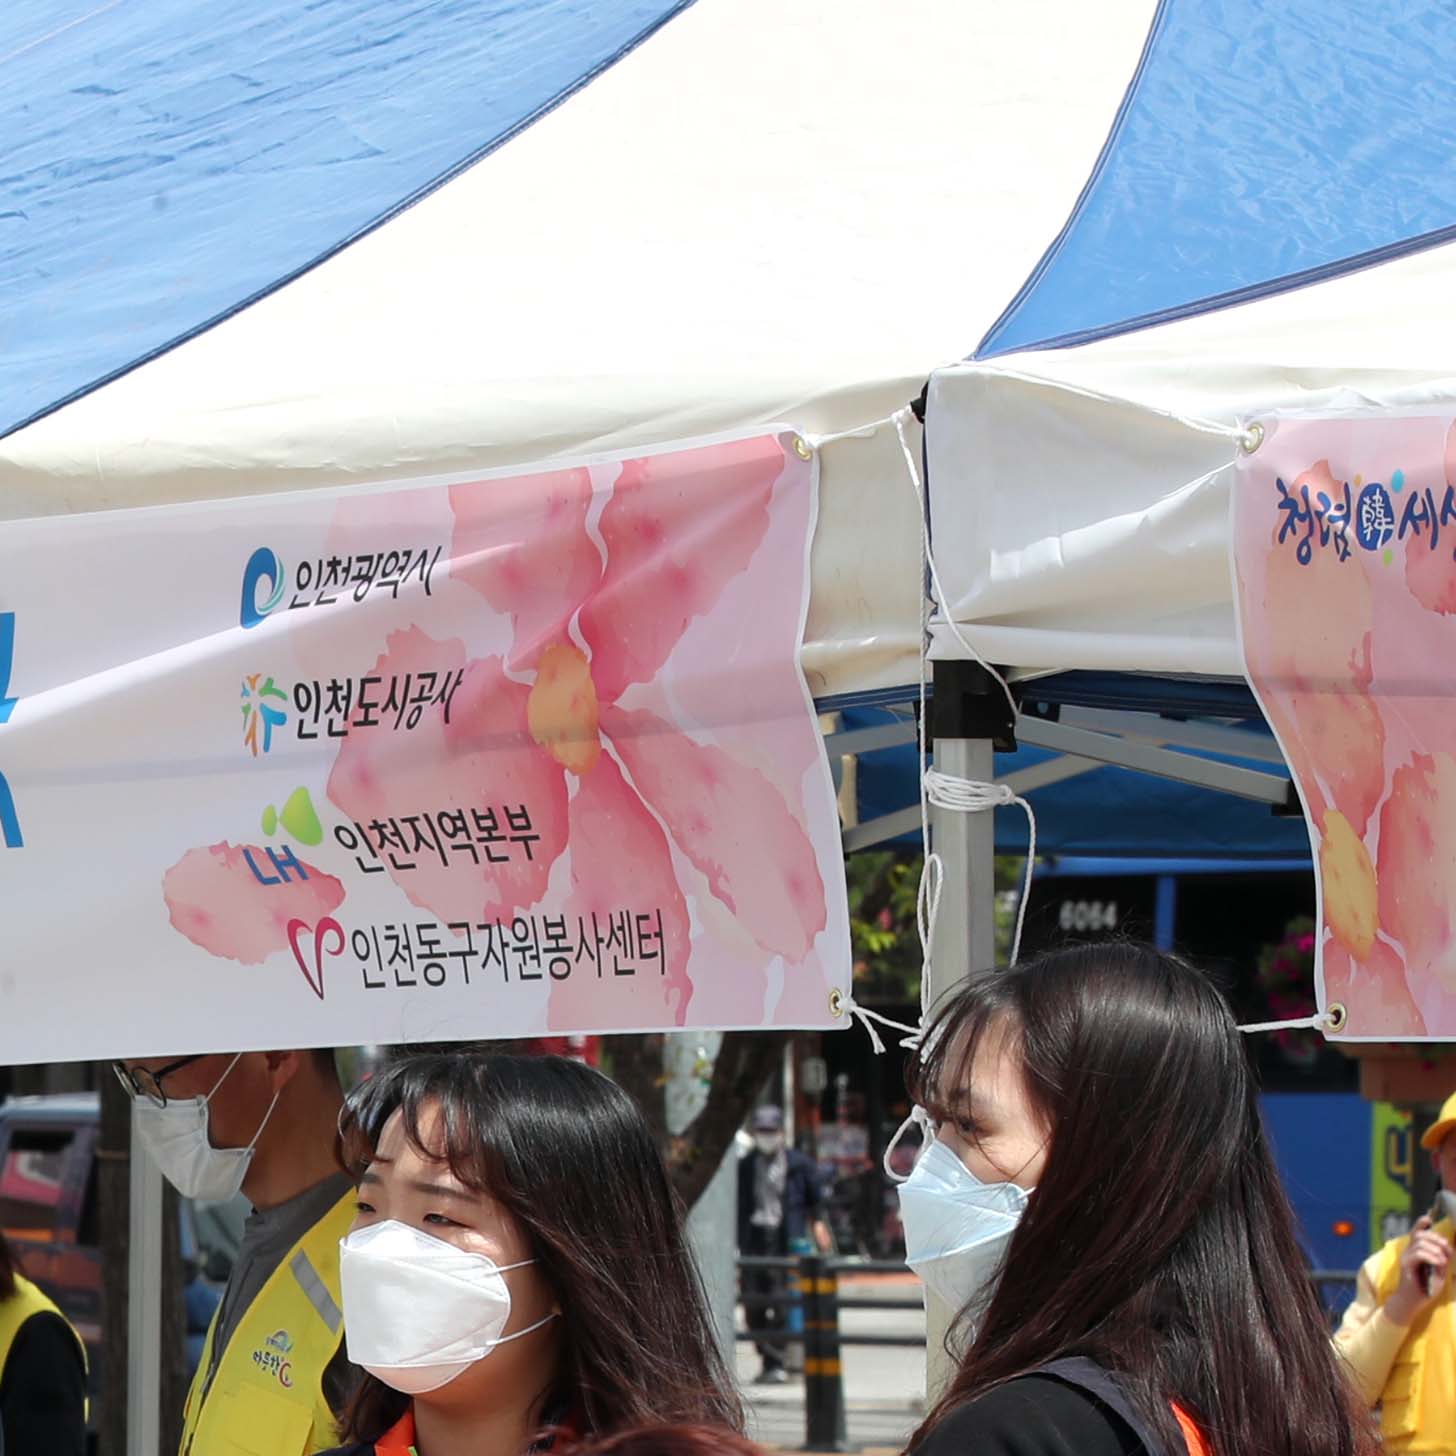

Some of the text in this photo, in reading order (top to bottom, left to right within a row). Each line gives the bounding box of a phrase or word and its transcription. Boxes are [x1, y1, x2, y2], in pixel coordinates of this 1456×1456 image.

[289, 546, 442, 610] 인천광역시
[292, 667, 464, 740] 인천도시공사
[242, 844, 309, 886] LH
[333, 803, 541, 874] 인천지역본부
[350, 909, 667, 990] 인천동구자원봉사센터
